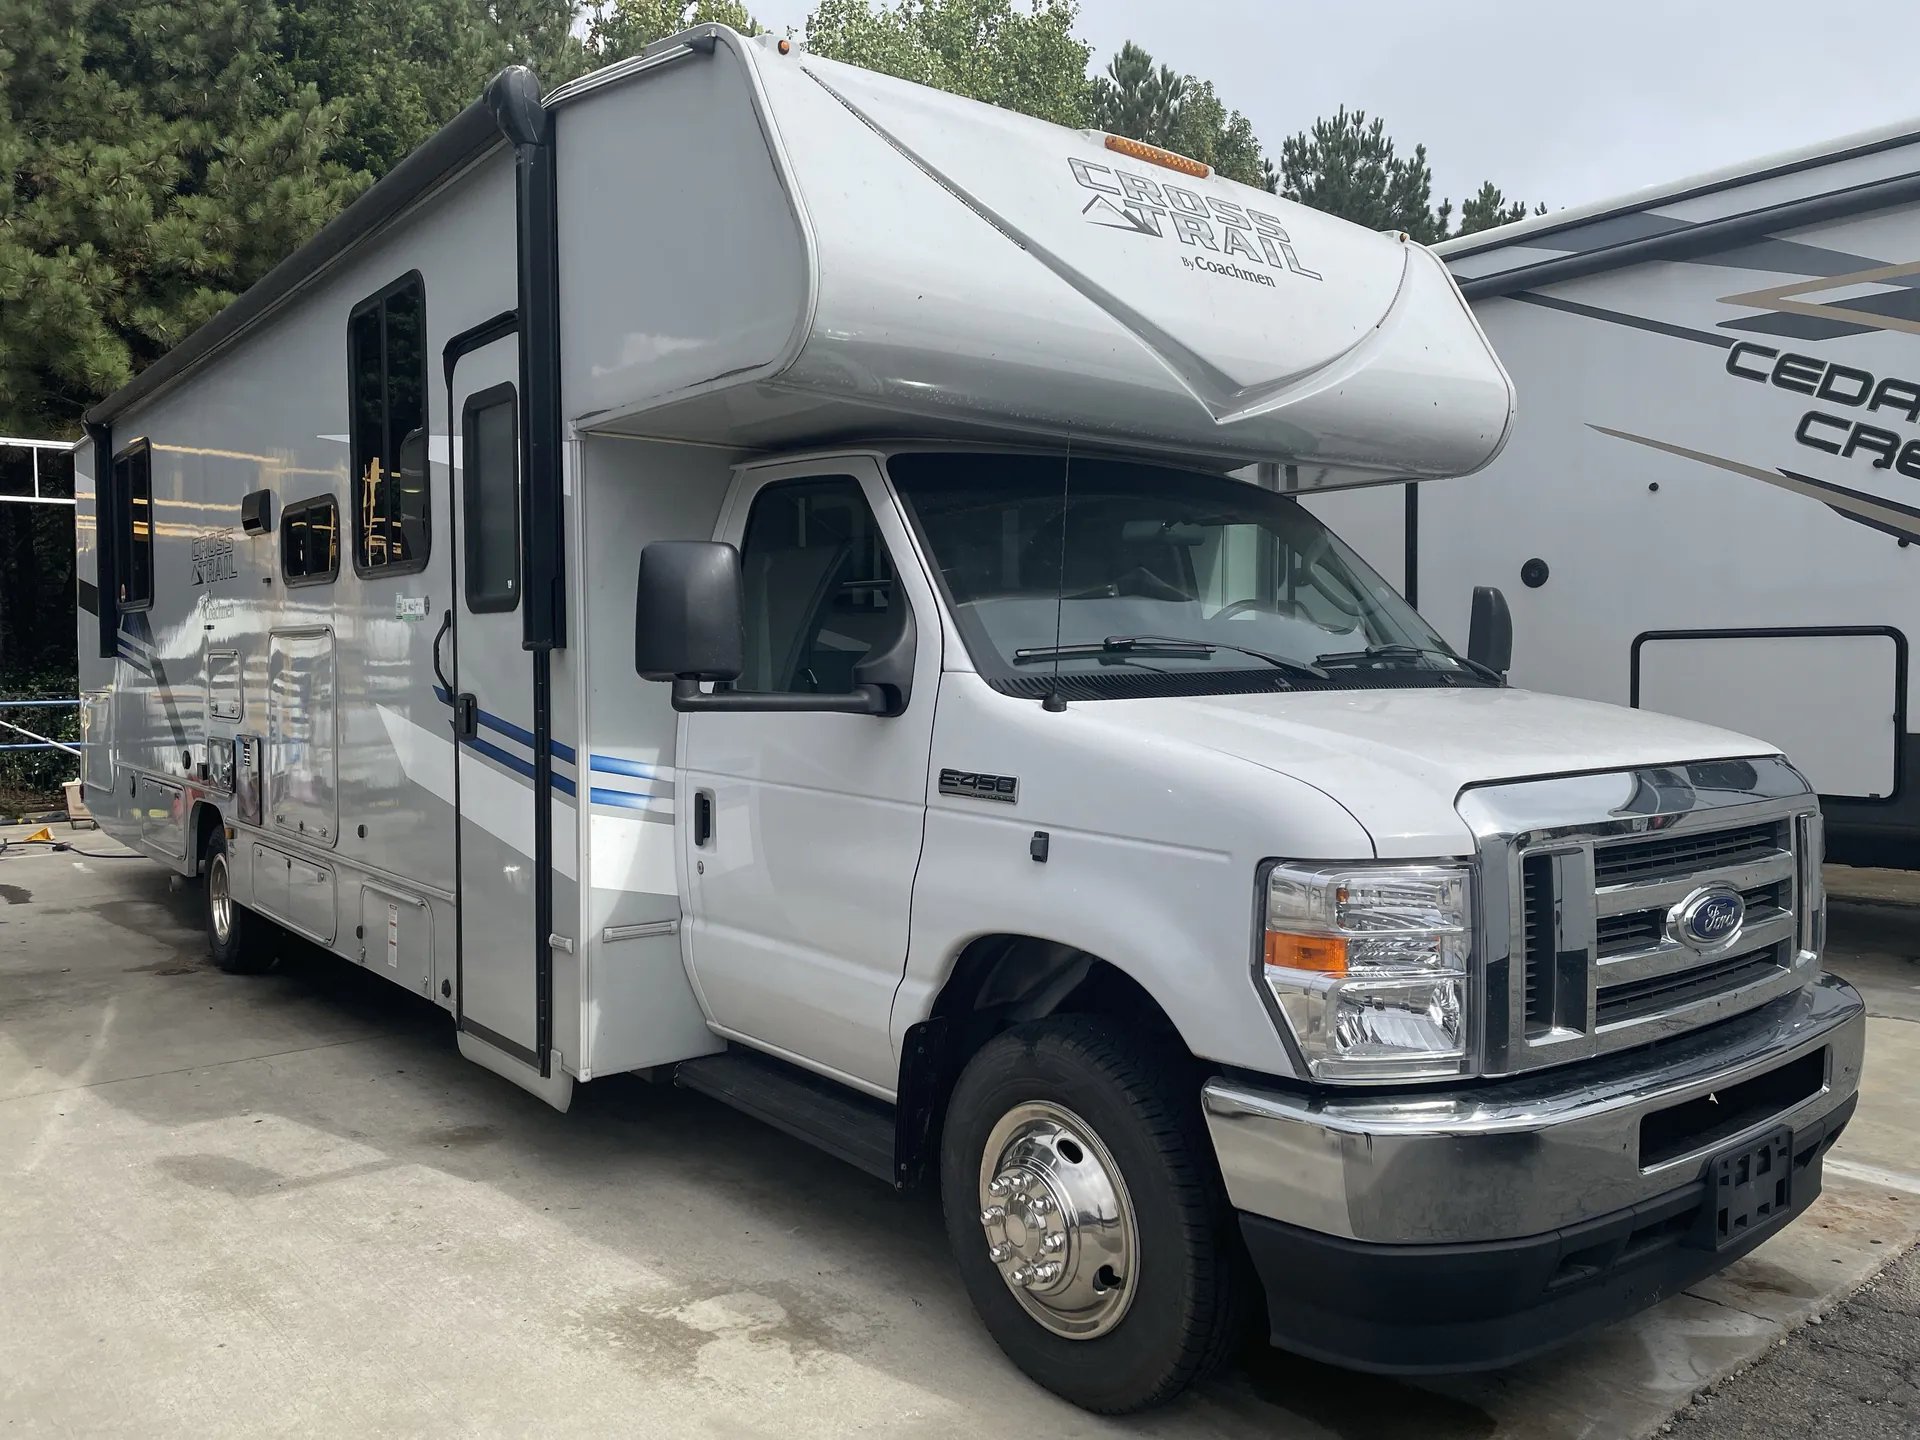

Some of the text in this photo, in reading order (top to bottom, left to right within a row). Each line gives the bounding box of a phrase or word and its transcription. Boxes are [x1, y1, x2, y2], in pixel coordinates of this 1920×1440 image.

[1067, 157, 1291, 243] CROSS
[1122, 199, 1323, 281] TRAIL
[1181, 256, 1276, 287] By Coachmen
[192, 527, 234, 561] CROSS
[198, 554, 238, 583] TRAIL
[1704, 902, 1735, 932] Ford
